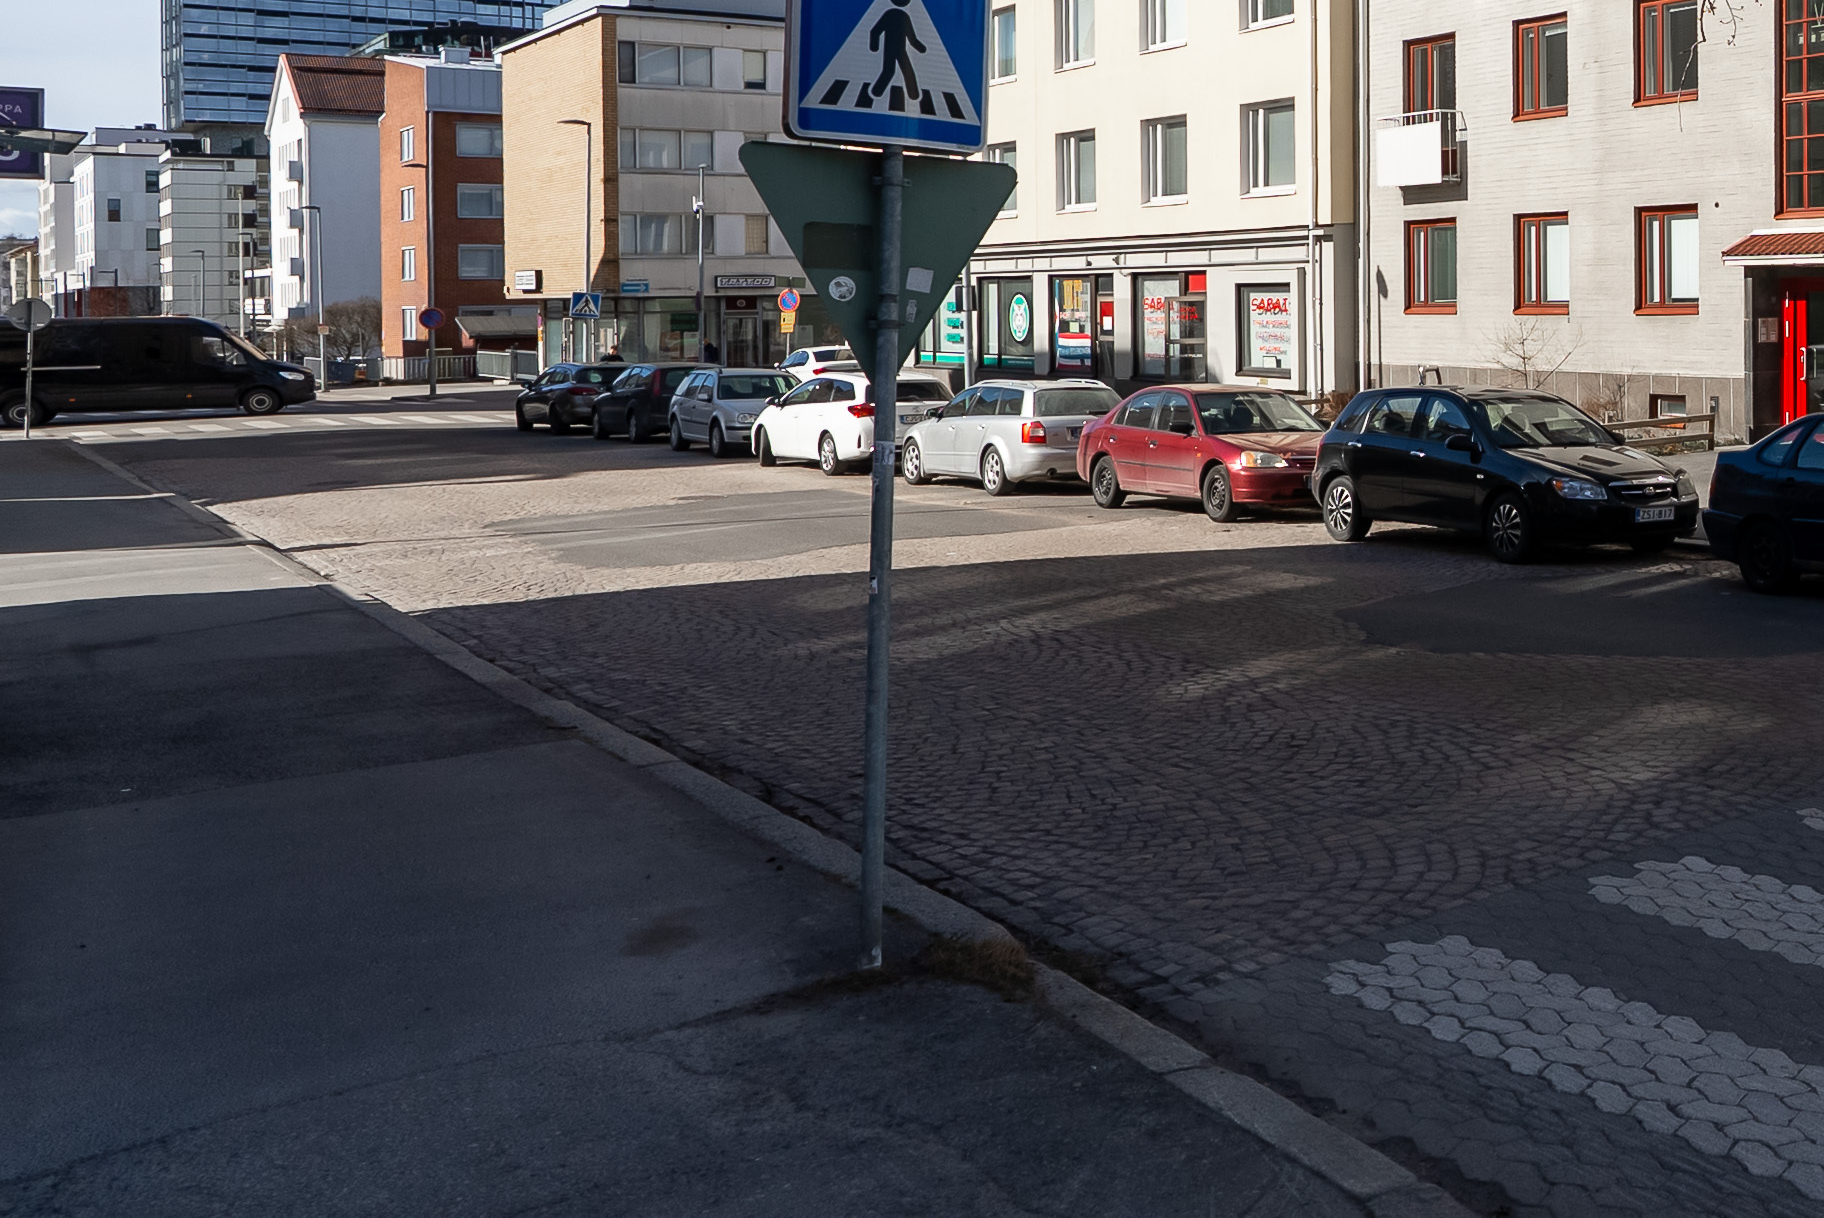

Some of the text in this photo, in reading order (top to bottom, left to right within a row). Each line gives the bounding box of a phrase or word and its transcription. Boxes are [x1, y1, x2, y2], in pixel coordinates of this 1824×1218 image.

[720, 277, 771, 286] TATTOO
[1251, 297, 1289, 312] SABAI
[1640, 508, 1673, 520] ZSI-817
